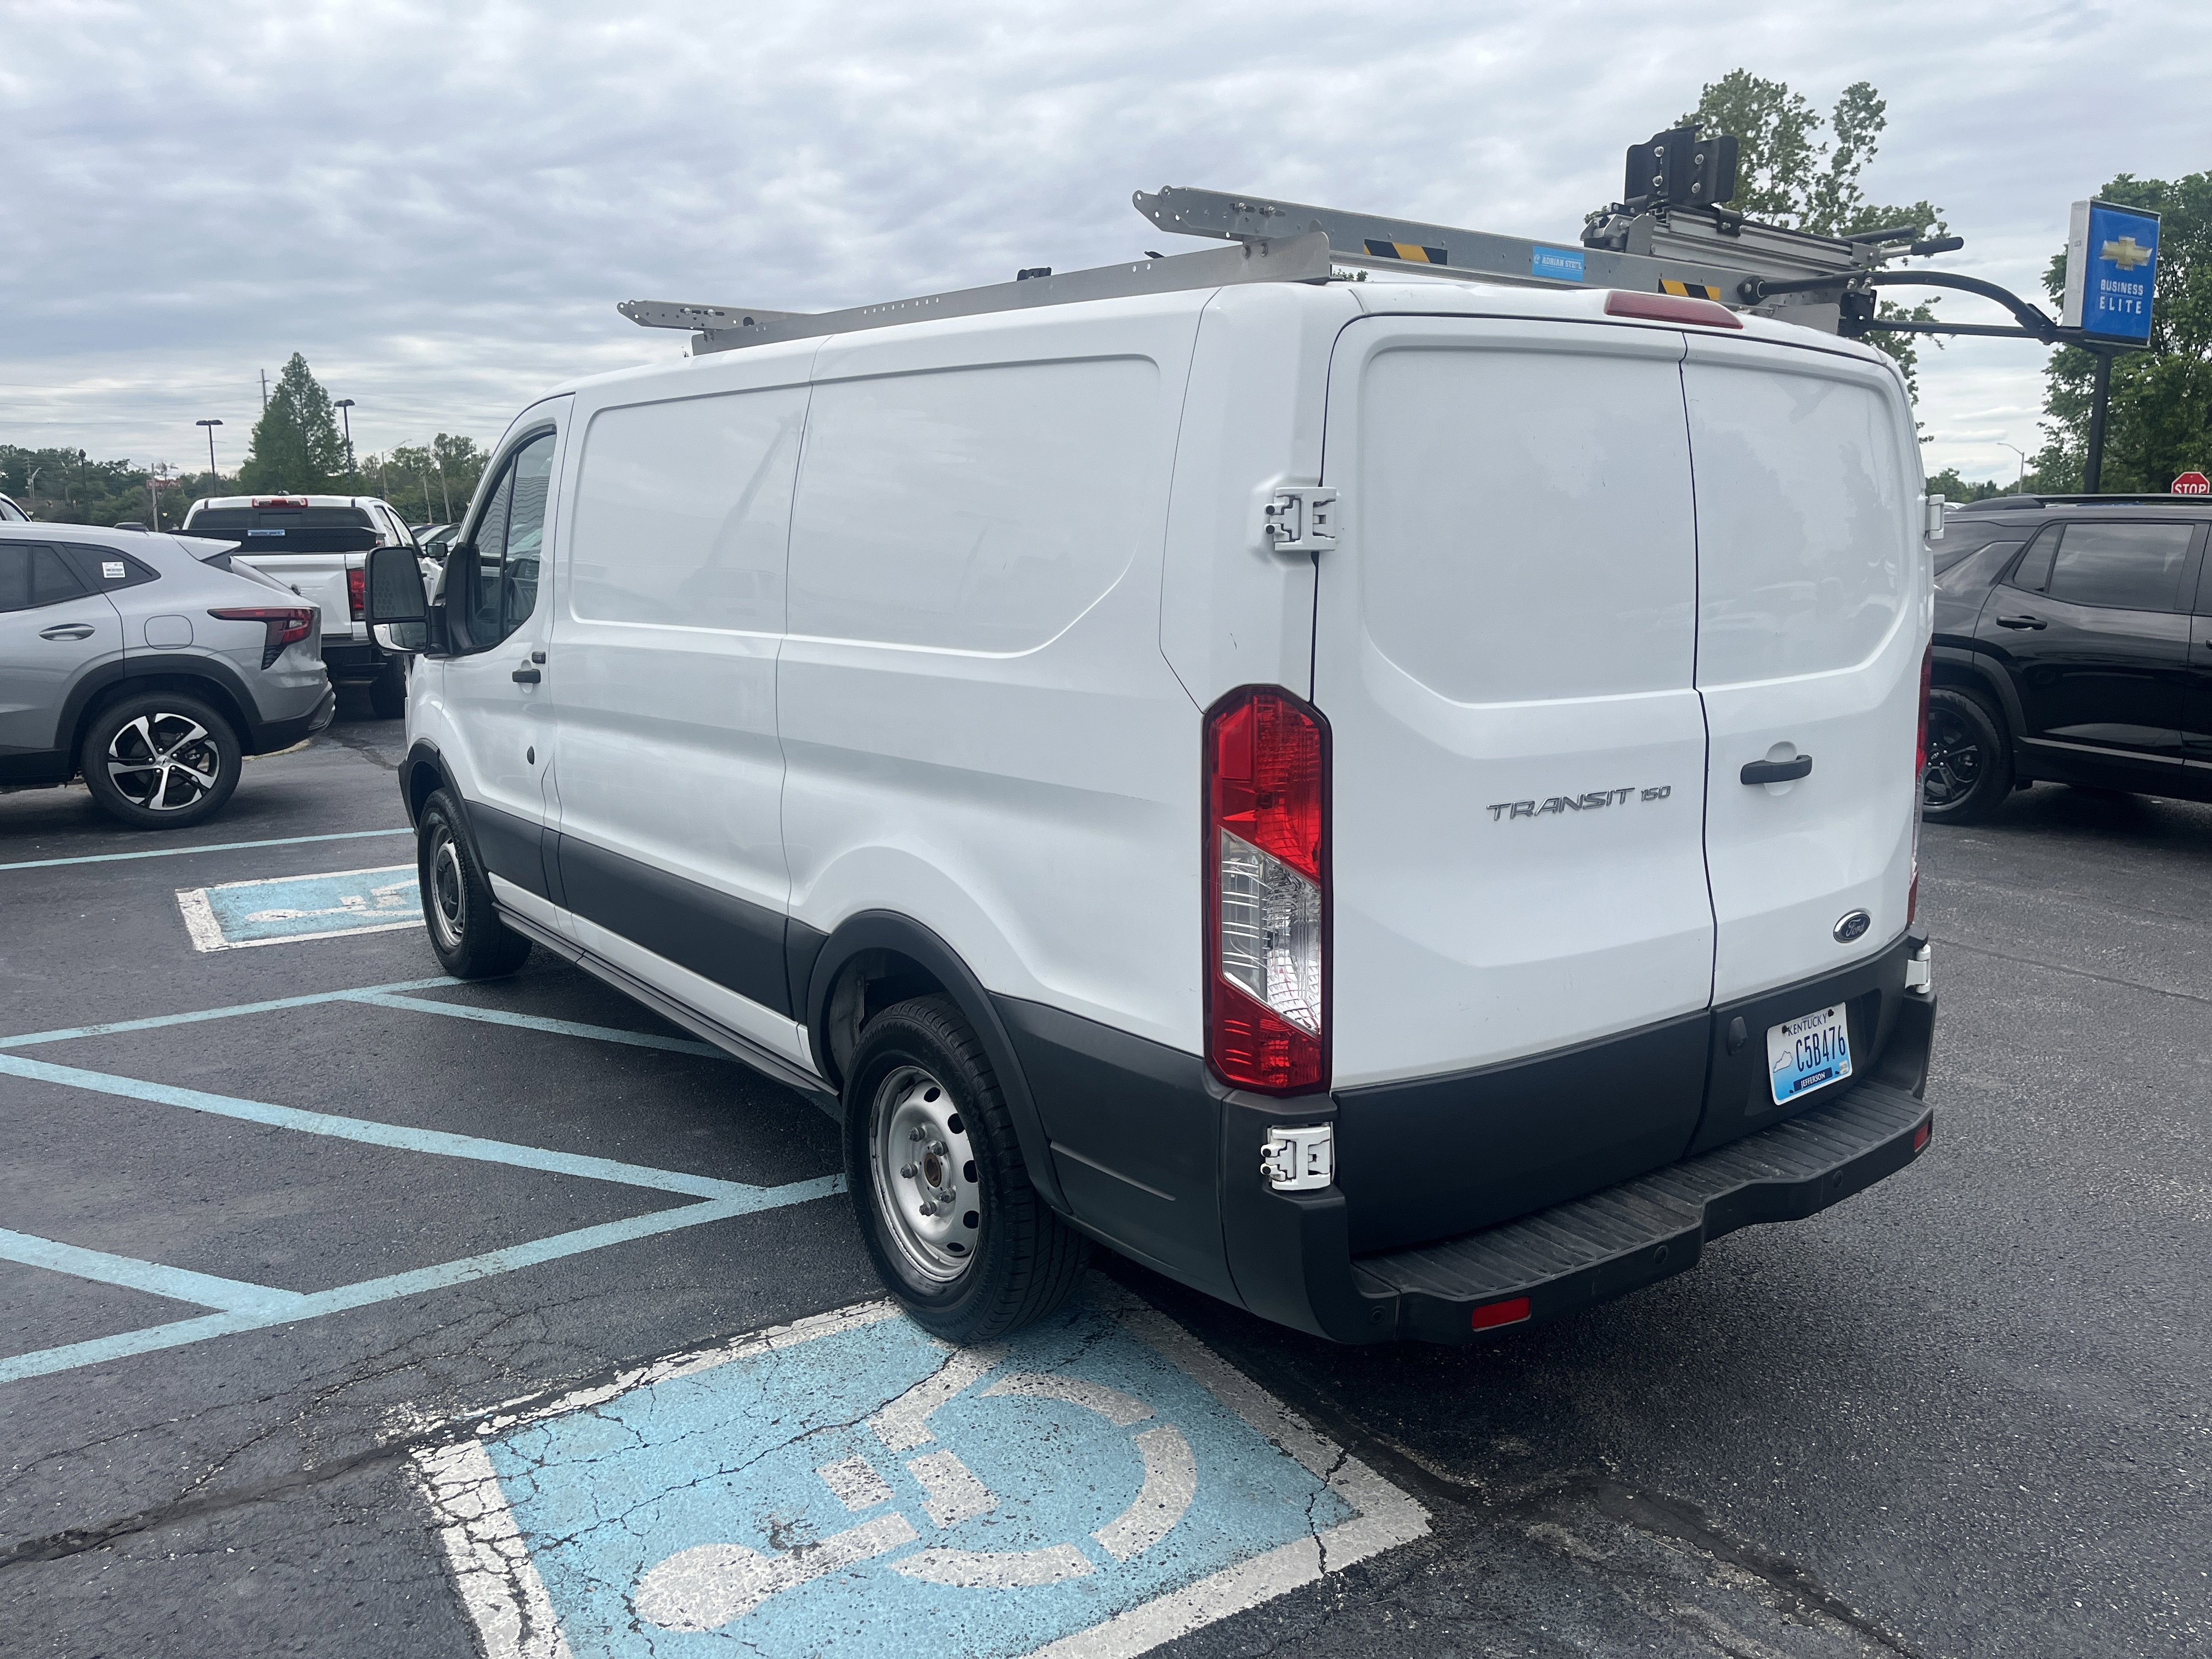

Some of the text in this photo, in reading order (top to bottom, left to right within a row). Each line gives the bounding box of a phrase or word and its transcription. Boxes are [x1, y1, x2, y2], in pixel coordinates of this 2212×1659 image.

[1542, 256, 1564, 267] ADRIAN
[2101, 279, 2143, 296] BUSINESS
[2100, 296, 2142, 314] ELITE
[2175, 483, 2207, 494] STOP
[1486, 786, 1671, 821] TRANSIT 150
[1846, 918, 1865, 936] Ford
[1788, 1013, 1827, 1036] KENTUCKY
[1796, 1025, 1846, 1072] C5B476
[1801, 1071, 1825, 1089] JEFFERSON
